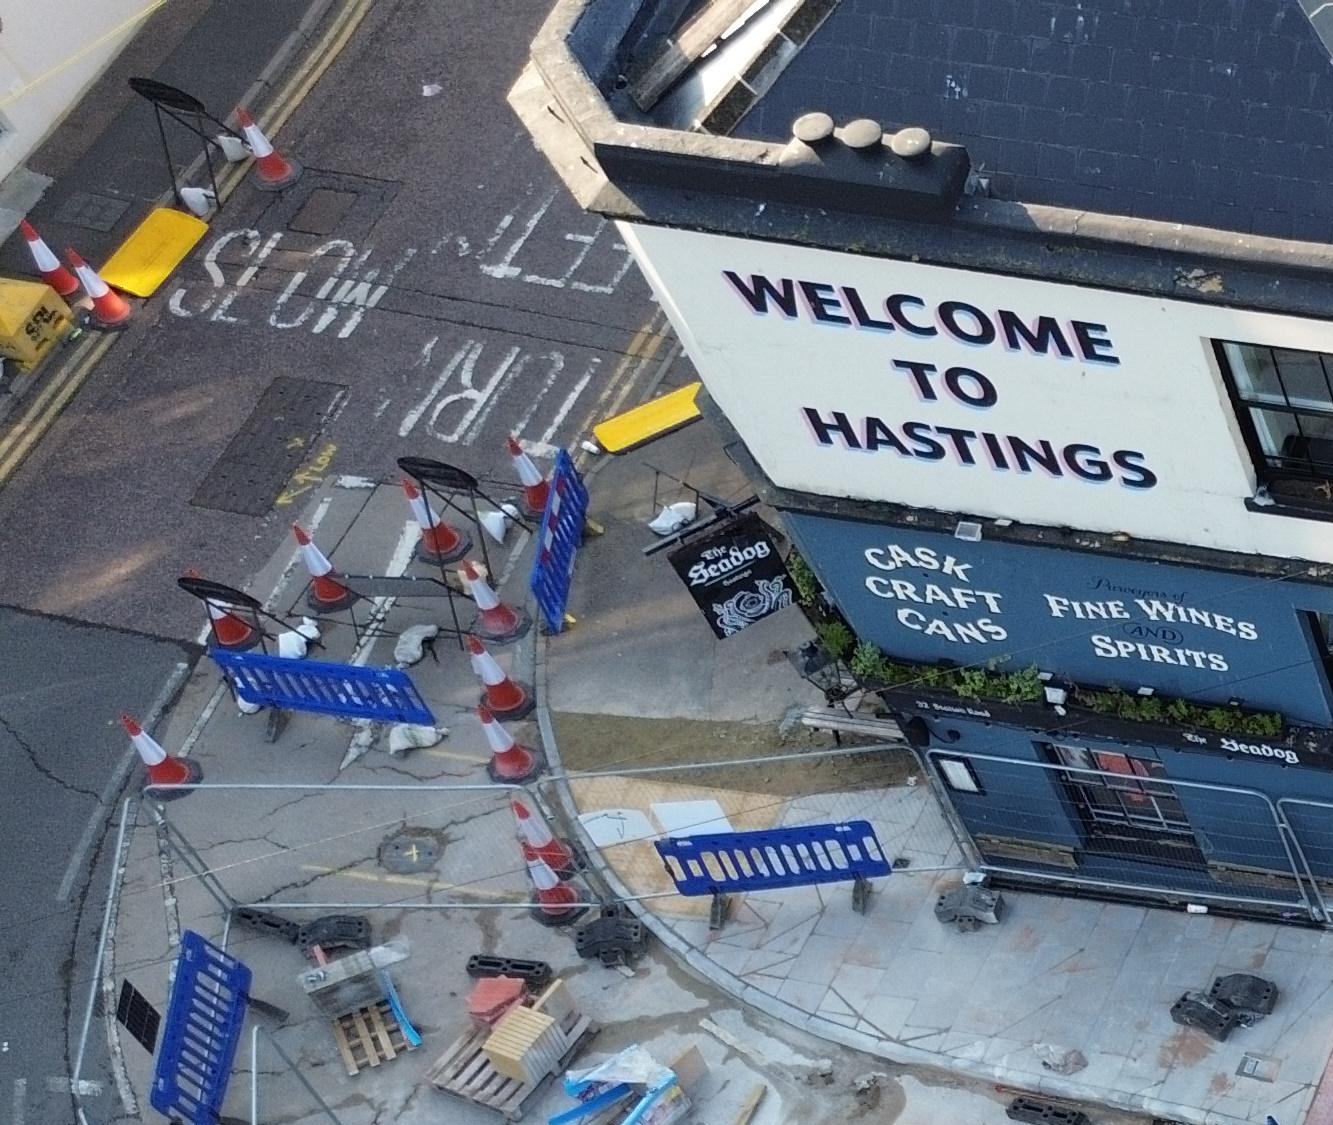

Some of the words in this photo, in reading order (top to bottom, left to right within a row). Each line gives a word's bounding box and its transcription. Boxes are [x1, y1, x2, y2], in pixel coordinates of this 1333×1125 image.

[480, 189, 637, 295] EFT
[168, 227, 418, 339] SLOW
[721, 269, 1121, 367] WELCOME
[891, 358, 999, 410] TO
[802, 405, 1158, 490] HASTINGS
[688, 541, 771, 586] Seadog
[700, 546, 727, 560] The
[864, 543, 974, 583] CASK
[864, 575, 1003, 615] CRAFT
[1087, 576, 1168, 599] Purveyors
[1172, 591, 1189, 604] of
[896, 608, 1009, 644] CANS
[1043, 593, 1131, 620] FINE
[1134, 598, 1259, 641] WINES
[1130, 625, 1177, 641] AND
[1090, 635, 1229, 672] SPIRITS
[1183, 732, 1208, 745] The
[1219, 737, 1300, 764] Seadog
